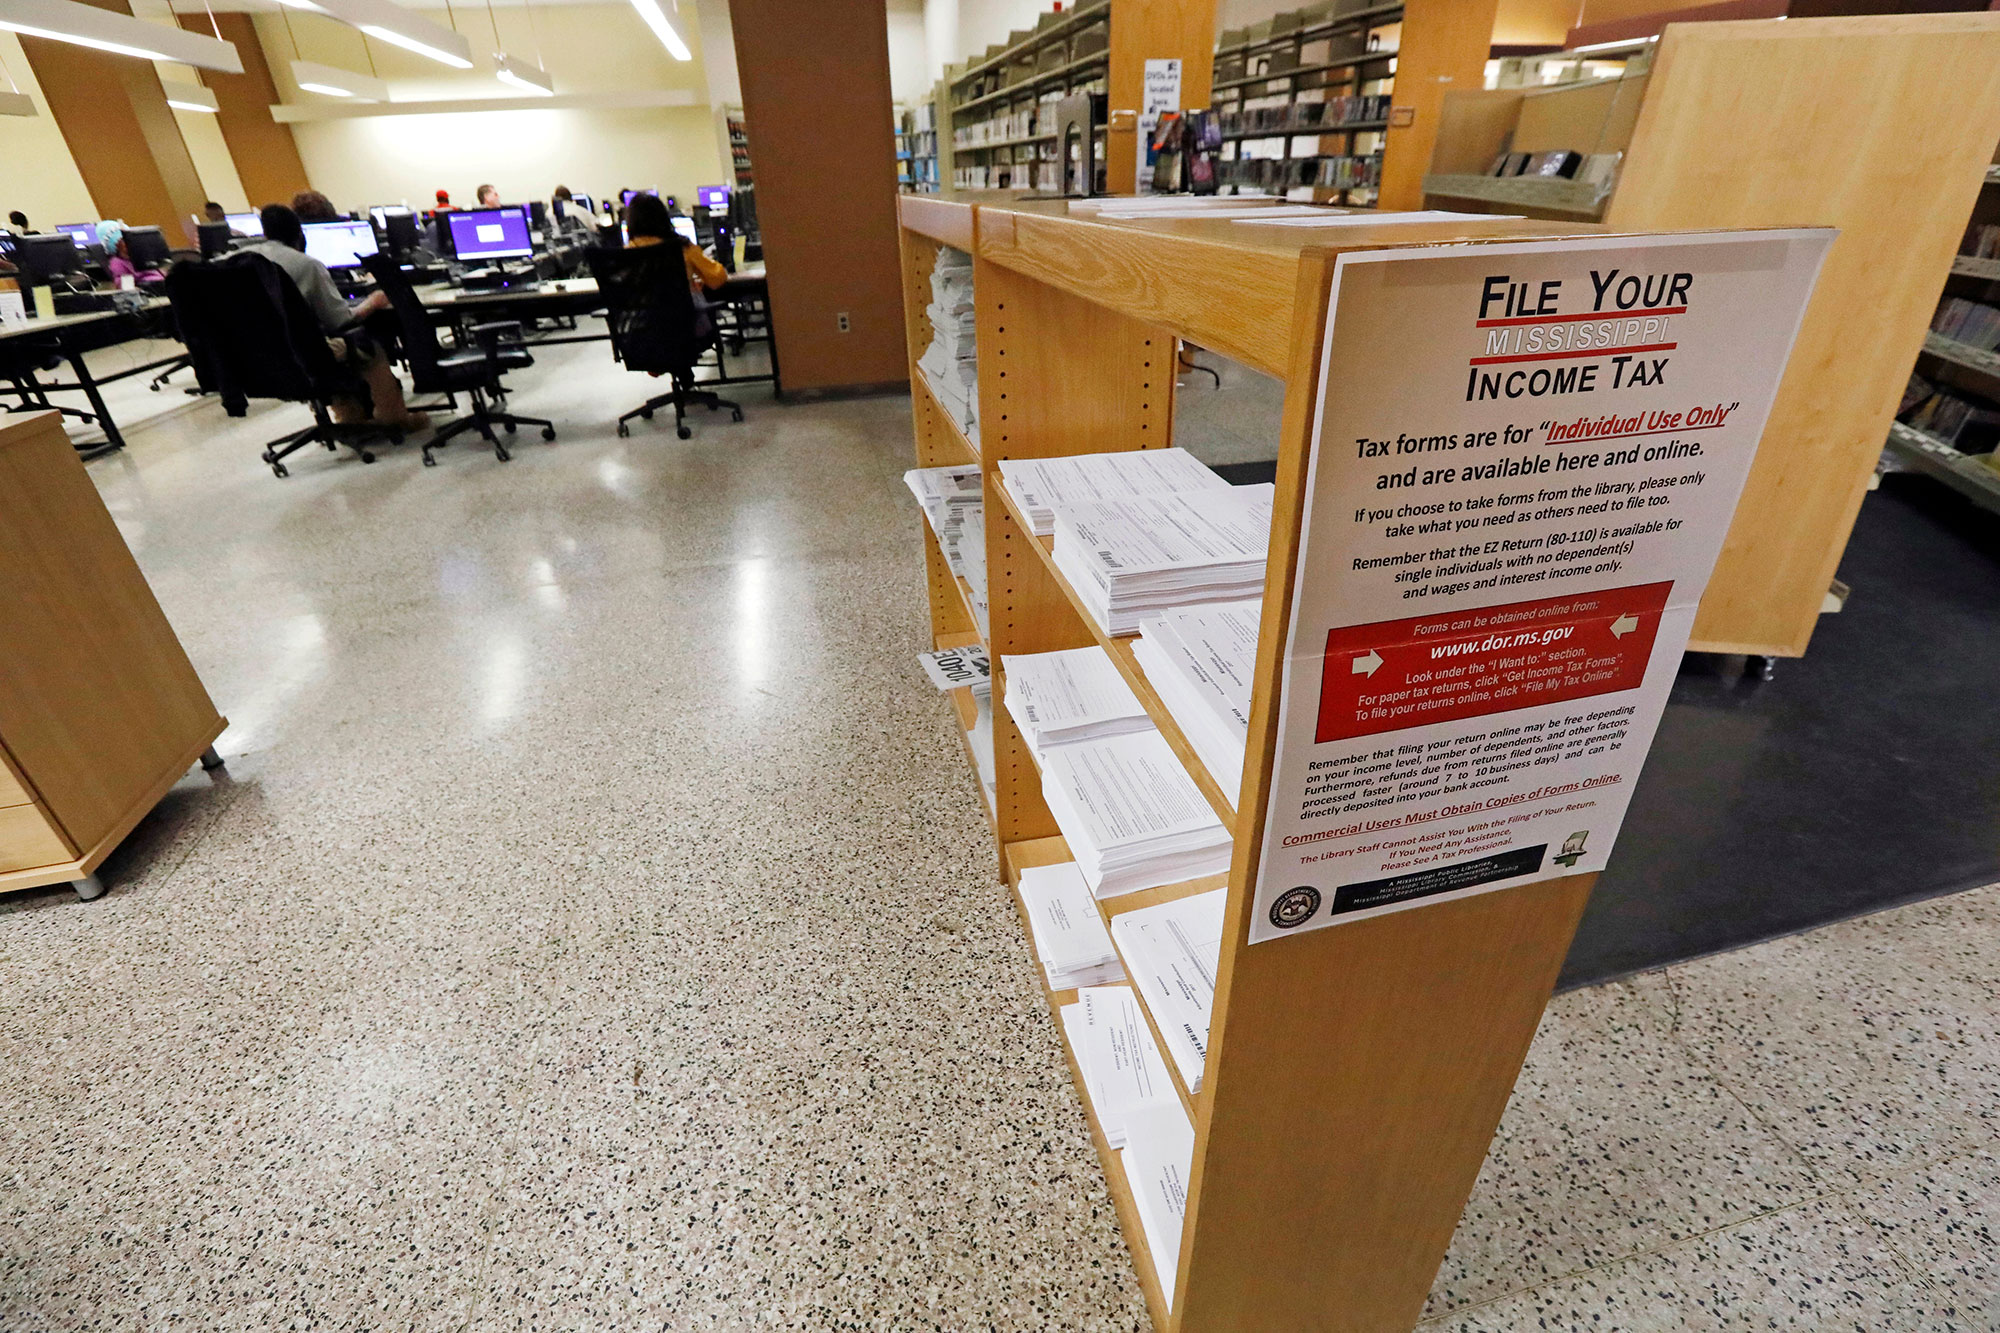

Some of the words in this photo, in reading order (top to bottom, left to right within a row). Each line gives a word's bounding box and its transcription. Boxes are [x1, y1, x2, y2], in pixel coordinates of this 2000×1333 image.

[1485, 317, 1670, 356] MISSISSIPPI
[1355, 438, 1391, 458] Tax
[1396, 433, 1458, 454] forms
[1464, 429, 1497, 448] are
[1503, 424, 1534, 444] for
[1646, 411, 1683, 433] Use
[1376, 466, 1417, 490] and
[1421, 468, 1456, 485] are
[1461, 454, 1551, 481] available
[1555, 452, 1599, 472] here
[1603, 443, 1641, 466] and
[1643, 439, 1704, 462] online.
[1354, 508, 1366, 522] If
[1368, 509, 1393, 524] you
[1396, 503, 1445, 518] choose
[1448, 500, 1463, 512] to
[1466, 495, 1494, 510] take
[1497, 493, 1535, 507] forms
[1537, 488, 1568, 502] from
[1571, 484, 1592, 498] the
[1594, 481, 1635, 495] library,
[1637, 476, 1677, 493] please
[1679, 470, 1706, 486] only
[1385, 523, 1415, 538] take
[1418, 519, 1453, 534] what
[1455, 518, 1480, 533] you
[1482, 510, 1516, 527] need
[1517, 511, 1532, 522] as
[1534, 506, 1574, 520] others
[1576, 499, 1609, 515] need
[1610, 500, 1624, 511] to
[1626, 495, 1645, 509] file
[1647, 495, 1670, 506] too.
[1352, 551, 1427, 570] Remember
[1429, 547, 1456, 561] that
[1459, 544, 1480, 557] the
[1483, 540, 1499, 554] EZ
[1501, 538, 1543, 551] Return
[1546, 527, 1597, 548] (80-110)
[1599, 527, 1609, 539] is
[1611, 520, 1663, 538] available
[1665, 518, 1683, 530] for
[1394, 567, 1432, 583] single
[1435, 557, 1503, 577] individuals
[1506, 553, 1534, 568] with
[1536, 553, 1553, 564] no
[1555, 540, 1634, 562] dependent(s)
[1402, 584, 1429, 599] and
[1431, 581, 1470, 595] wages
[1472, 574, 1498, 589] and
[1499, 569, 1546, 586] interest
[1548, 565, 1592, 579] income
[1594, 559, 1622, 573] only.
[1413, 622, 1449, 636] Forms
[1450, 619, 1471, 630] can
[1473, 616, 1487, 627] be
[1489, 607, 1537, 625] obtained
[1537, 604, 1570, 618] online
[1571, 601, 1598, 612] from:
[1405, 670, 1433, 684] Look
[1435, 665, 1467, 680] under
[1468, 663, 1485, 674] the
[1499, 655, 1525, 669] Want
[1547, 647, 1587, 661] section.
[1431, 626, 1574, 659] www.dor.ms.gov
[1355, 709, 1368, 721] To
[1371, 706, 1388, 718] file
[1389, 703, 1415, 718] your
[1416, 697, 1455, 711] returns
[1457, 691, 1491, 704] online,
[1494, 684, 1518, 698] click
[1545, 677, 1561, 690] My
[1563, 675, 1580, 686] Tax
[1358, 694, 1377, 706] For
[1378, 690, 1411, 705] paper
[1413, 687, 1430, 697] tax
[1431, 680, 1472, 694] returns,
[1474, 673, 1499, 687] click
[1526, 665, 1564, 679] Income
[1566, 660, 1583, 672] Tax
[1306, 775, 1321, 783] on
[1324, 769, 1350, 781] your
[1353, 762, 1392, 775] income
[1395, 755, 1422, 768] level,
[1426, 748, 1467, 762] number
[1469, 743, 1482, 755] of
[1483, 735, 1543, 752] dependents,
[1546, 728, 1566, 740] and
[1568, 725, 1595, 736] other
[1597, 718, 1628, 730] factors.
[1308, 754, 1369, 771] Remember
[1372, 748, 1394, 760] that
[1397, 744, 1424, 755] filing
[1427, 739, 1451, 752] your
[1454, 733, 1486, 745] return
[1489, 727, 1521, 739] online
[1523, 723, 1546, 732] may
[1548, 719, 1561, 728] be
[1564, 716, 1583, 725] free
[1586, 706, 1636, 721] depending
[1301, 790, 1356, 810] processed
[1362, 786, 1393, 797] faster
[1398, 775, 1439, 792] (around
[1445, 773, 1452, 782] 7
[1458, 772, 1469, 780] to
[1475, 767, 1488, 777] 10
[1489, 760, 1531, 774] business
[1534, 752, 1559, 765] days)
[1564, 748, 1584, 759] and
[1588, 746, 1604, 755] can
[1609, 742, 1622, 750] be
[1304, 778, 1375, 796] Furthermore,
[1378, 768, 1418, 783] refunds
[1421, 765, 1441, 775] due
[1444, 760, 1468, 771] from
[1471, 753, 1507, 766] returns
[1509, 746, 1532, 759] filed
[1534, 742, 1564, 754] online
[1566, 739, 1583, 748] are
[1584, 729, 1627, 746] generally
[1282, 821, 1363, 846] Commercial
[1365, 817, 1401, 830] Users
[1404, 809, 1438, 823] Must
[1440, 801, 1483, 816] Obtain
[1485, 793, 1526, 808] Copies
[1527, 787, 1543, 799] of
[1543, 782, 1579, 796] Forms
[1582, 774, 1622, 789] Online.
[1300, 806, 1341, 820] directly
[1342, 795, 1395, 812] deposited
[1396, 793, 1416, 803] into
[1418, 788, 1442, 800] your
[1443, 781, 1468, 794] bank
[1469, 775, 1510, 789] account.
[1085, 994, 1094, 1025] REVENUE
